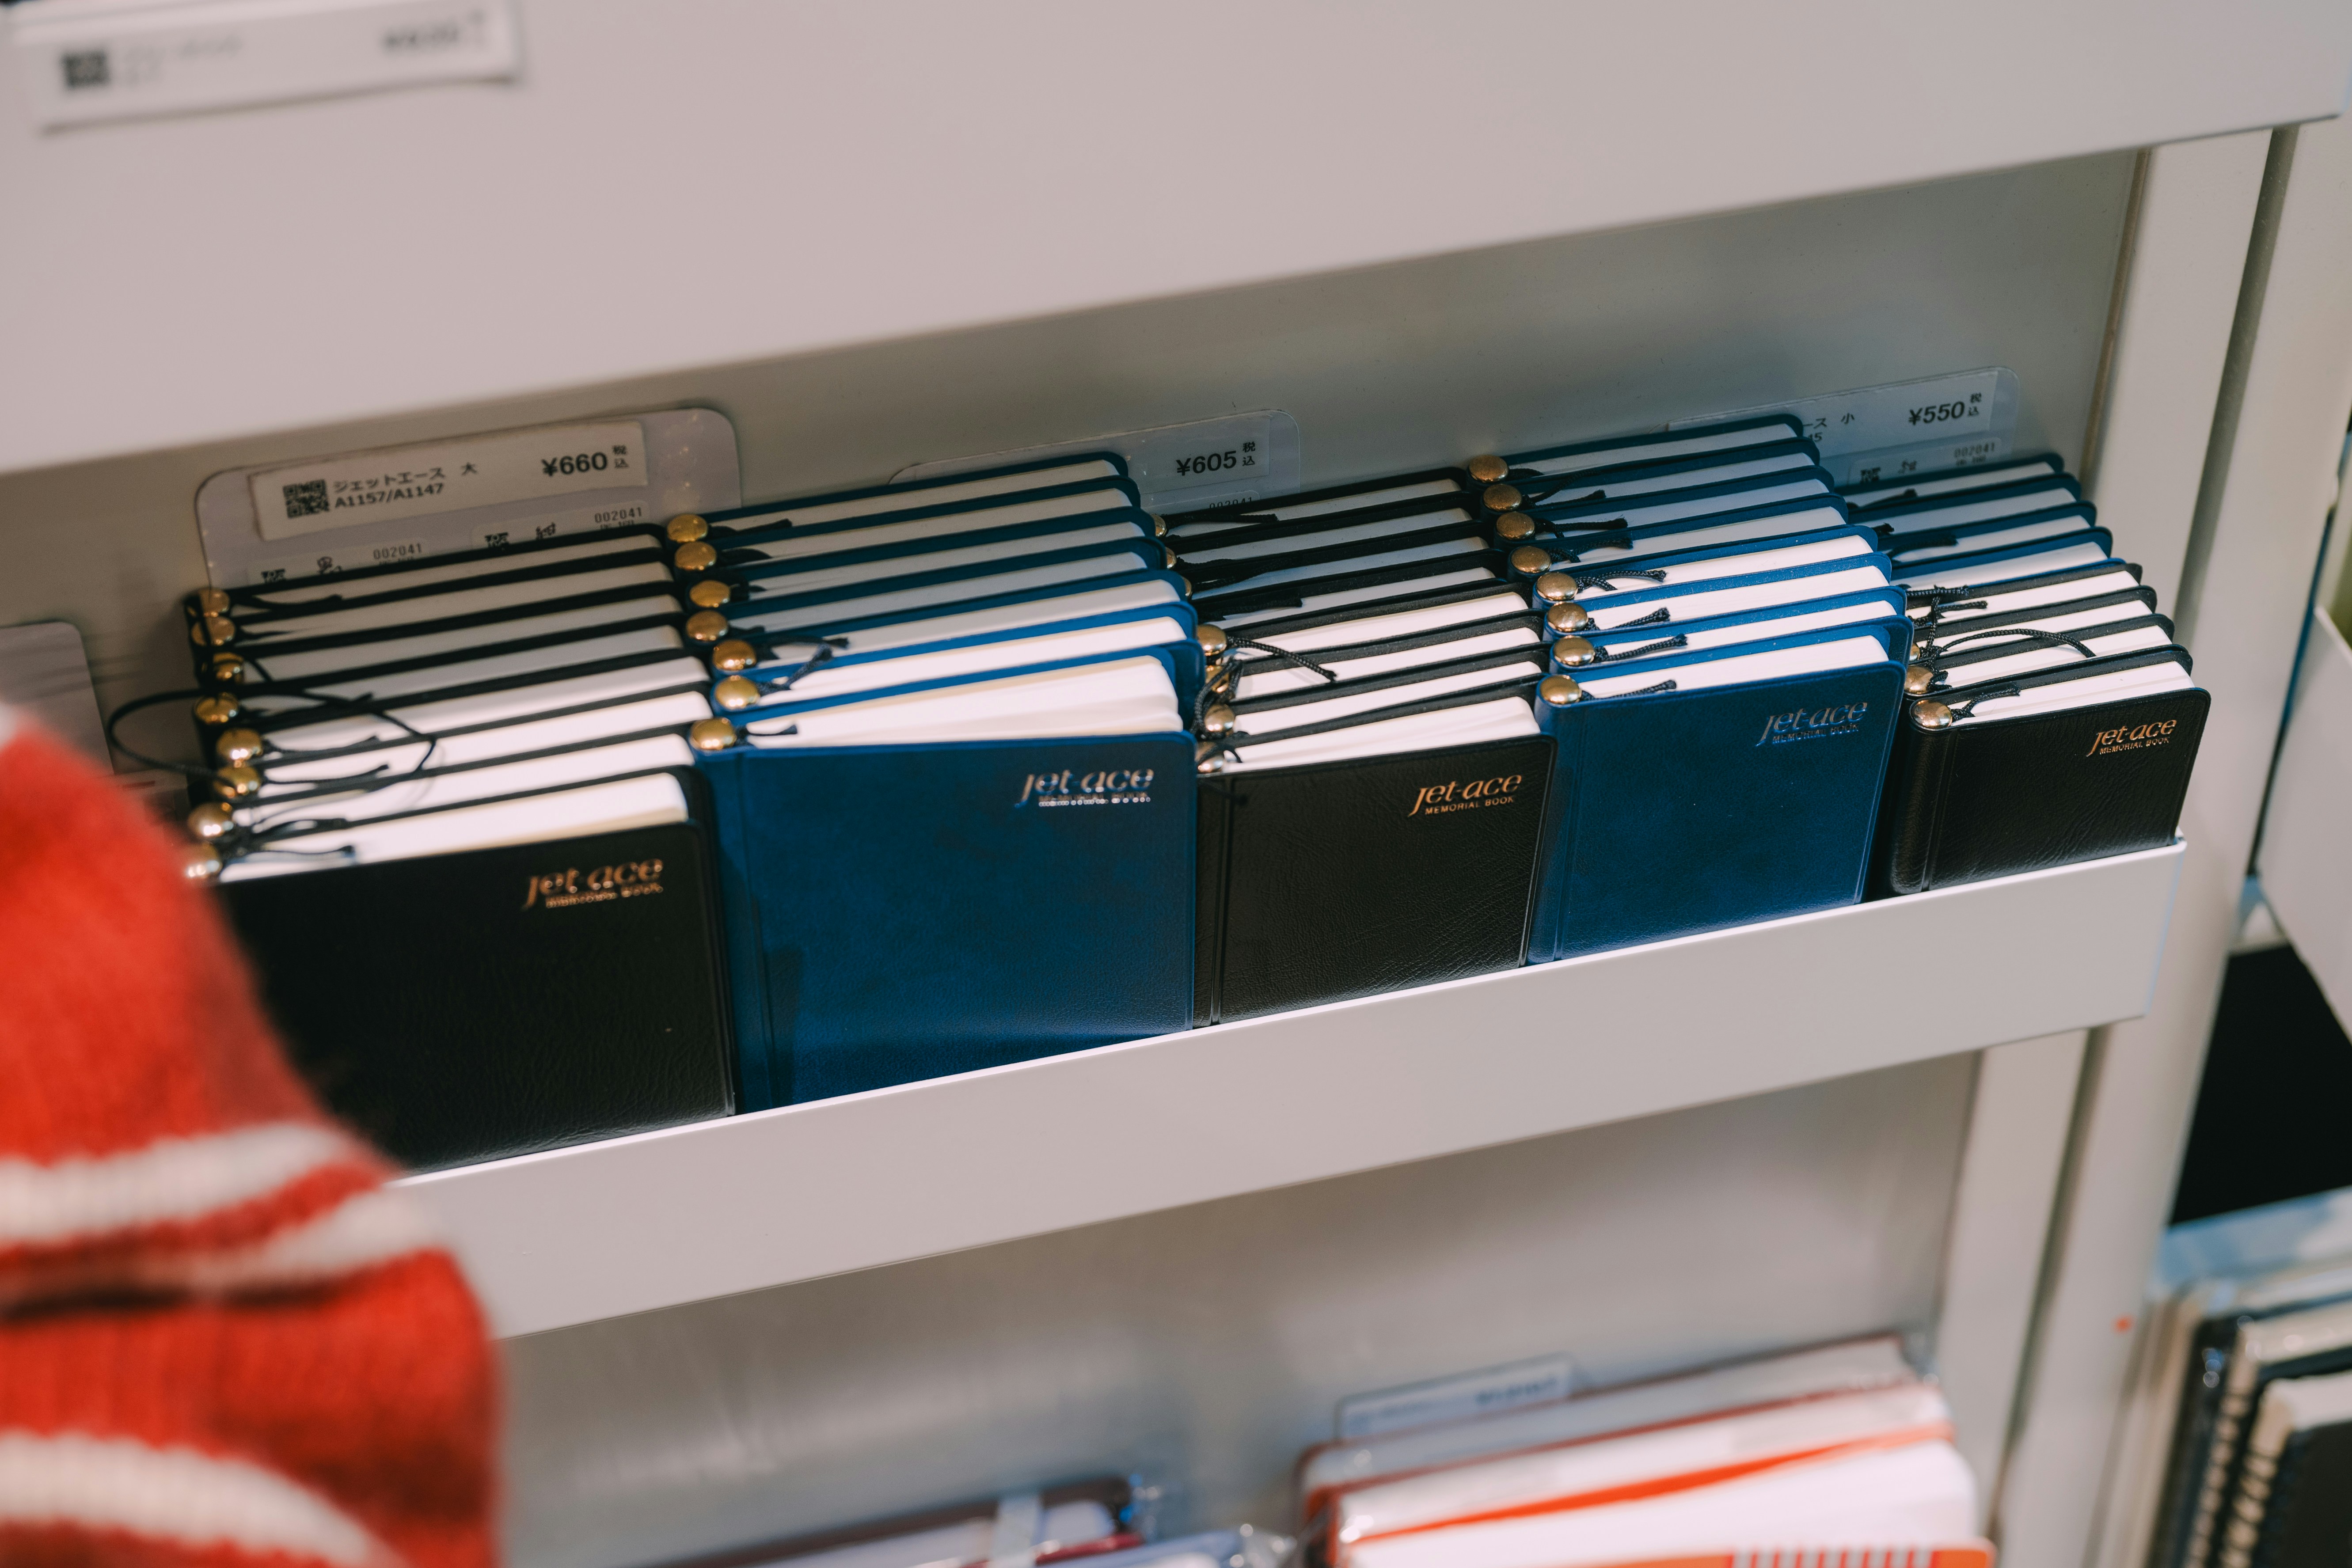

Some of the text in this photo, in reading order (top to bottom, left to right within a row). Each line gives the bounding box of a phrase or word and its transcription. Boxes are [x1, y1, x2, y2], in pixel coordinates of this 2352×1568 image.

[1840, 413, 1855, 425] 小
[1908, 401, 1965, 425] ¥550
[1176, 450, 1237, 476] ¥605
[1242, 441, 1256, 466] 税込
[541, 452, 608, 477] ¥660
[333, 462, 477, 494] ジェットエース 大
[335, 483, 444, 508] A1157/A1147
[594, 507, 642, 524] 002041
[373, 543, 422, 560] 002041
[1830, 724, 1859, 736] BOOK
[2100, 737, 2170, 755] MEMORIAL BOOK
[1425, 796, 1515, 815] MEMORIAL BOOK
